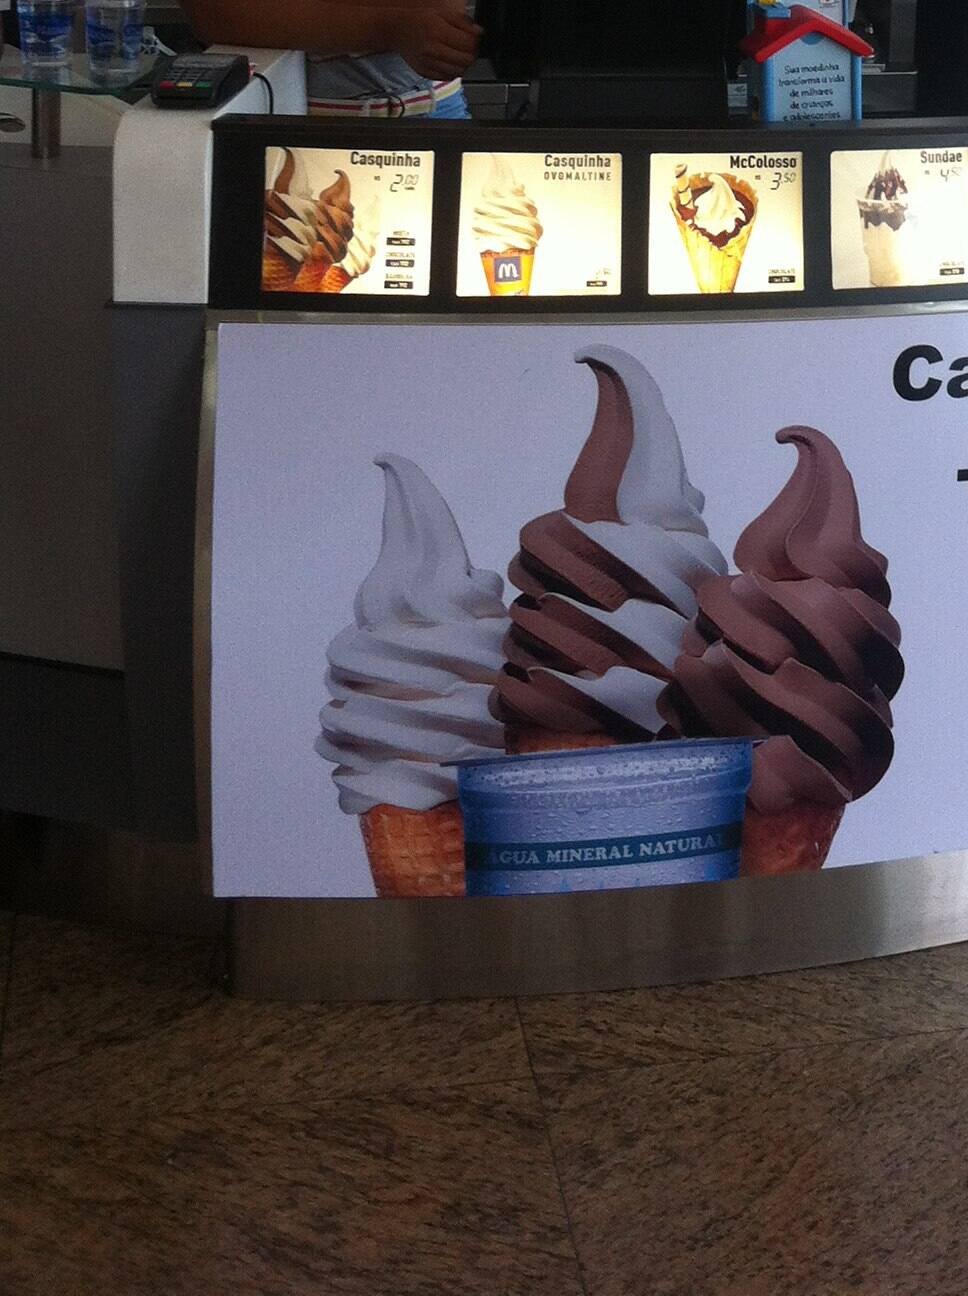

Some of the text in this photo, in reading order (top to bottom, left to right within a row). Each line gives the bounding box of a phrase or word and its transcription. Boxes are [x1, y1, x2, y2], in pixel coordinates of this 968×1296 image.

[784, 63, 839, 74] Sua moedinha
[778, 76, 820, 87] transforma
[828, 74, 845, 83] vida
[790, 88, 833, 97] de milhares
[790, 101, 799, 109] de
[350, 151, 421, 168] Casquinha
[544, 154, 611, 170] Casquinha
[730, 155, 797, 169] McColosso
[920, 150, 962, 164] Sundae
[543, 171, 612, 181] OVOMALTINE
[490, 850, 540, 865] GUA
[546, 845, 634, 864] MINERAL
